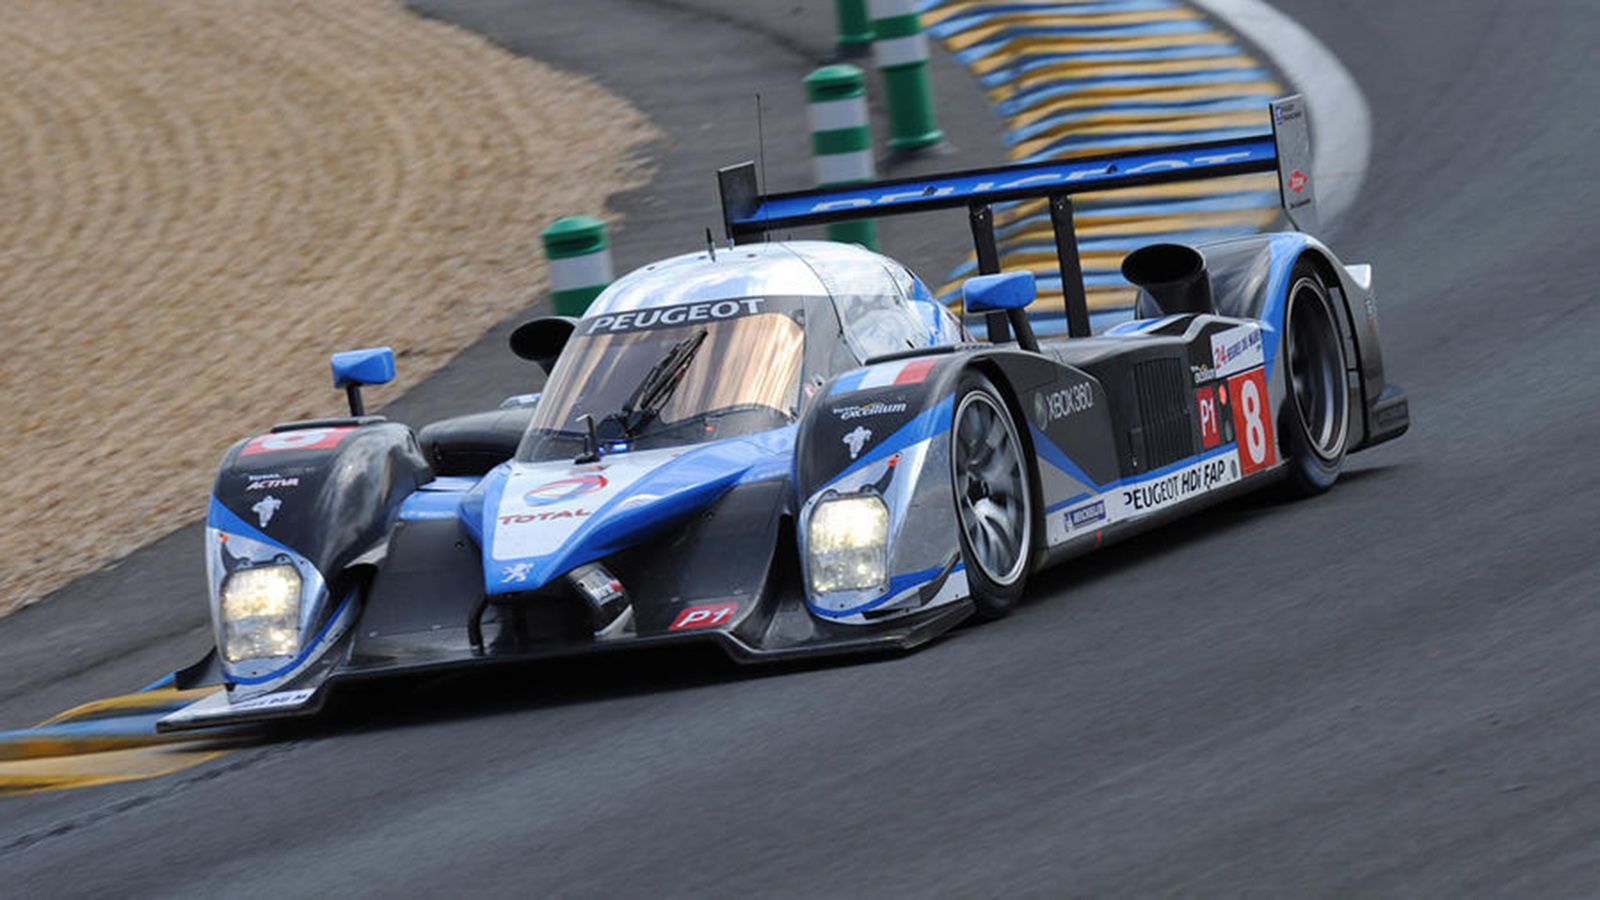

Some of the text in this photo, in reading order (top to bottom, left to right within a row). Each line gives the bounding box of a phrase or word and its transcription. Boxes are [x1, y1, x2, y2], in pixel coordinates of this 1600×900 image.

[586, 298, 764, 334] PEUGEOT
[1200, 397, 1217, 437] P1
[1241, 379, 1266, 464] 8
[1181, 467, 1201, 495] HDi
[1204, 460, 1225, 487] FAP
[499, 508, 591, 525] TOTAL
[677, 608, 731, 627] P1
